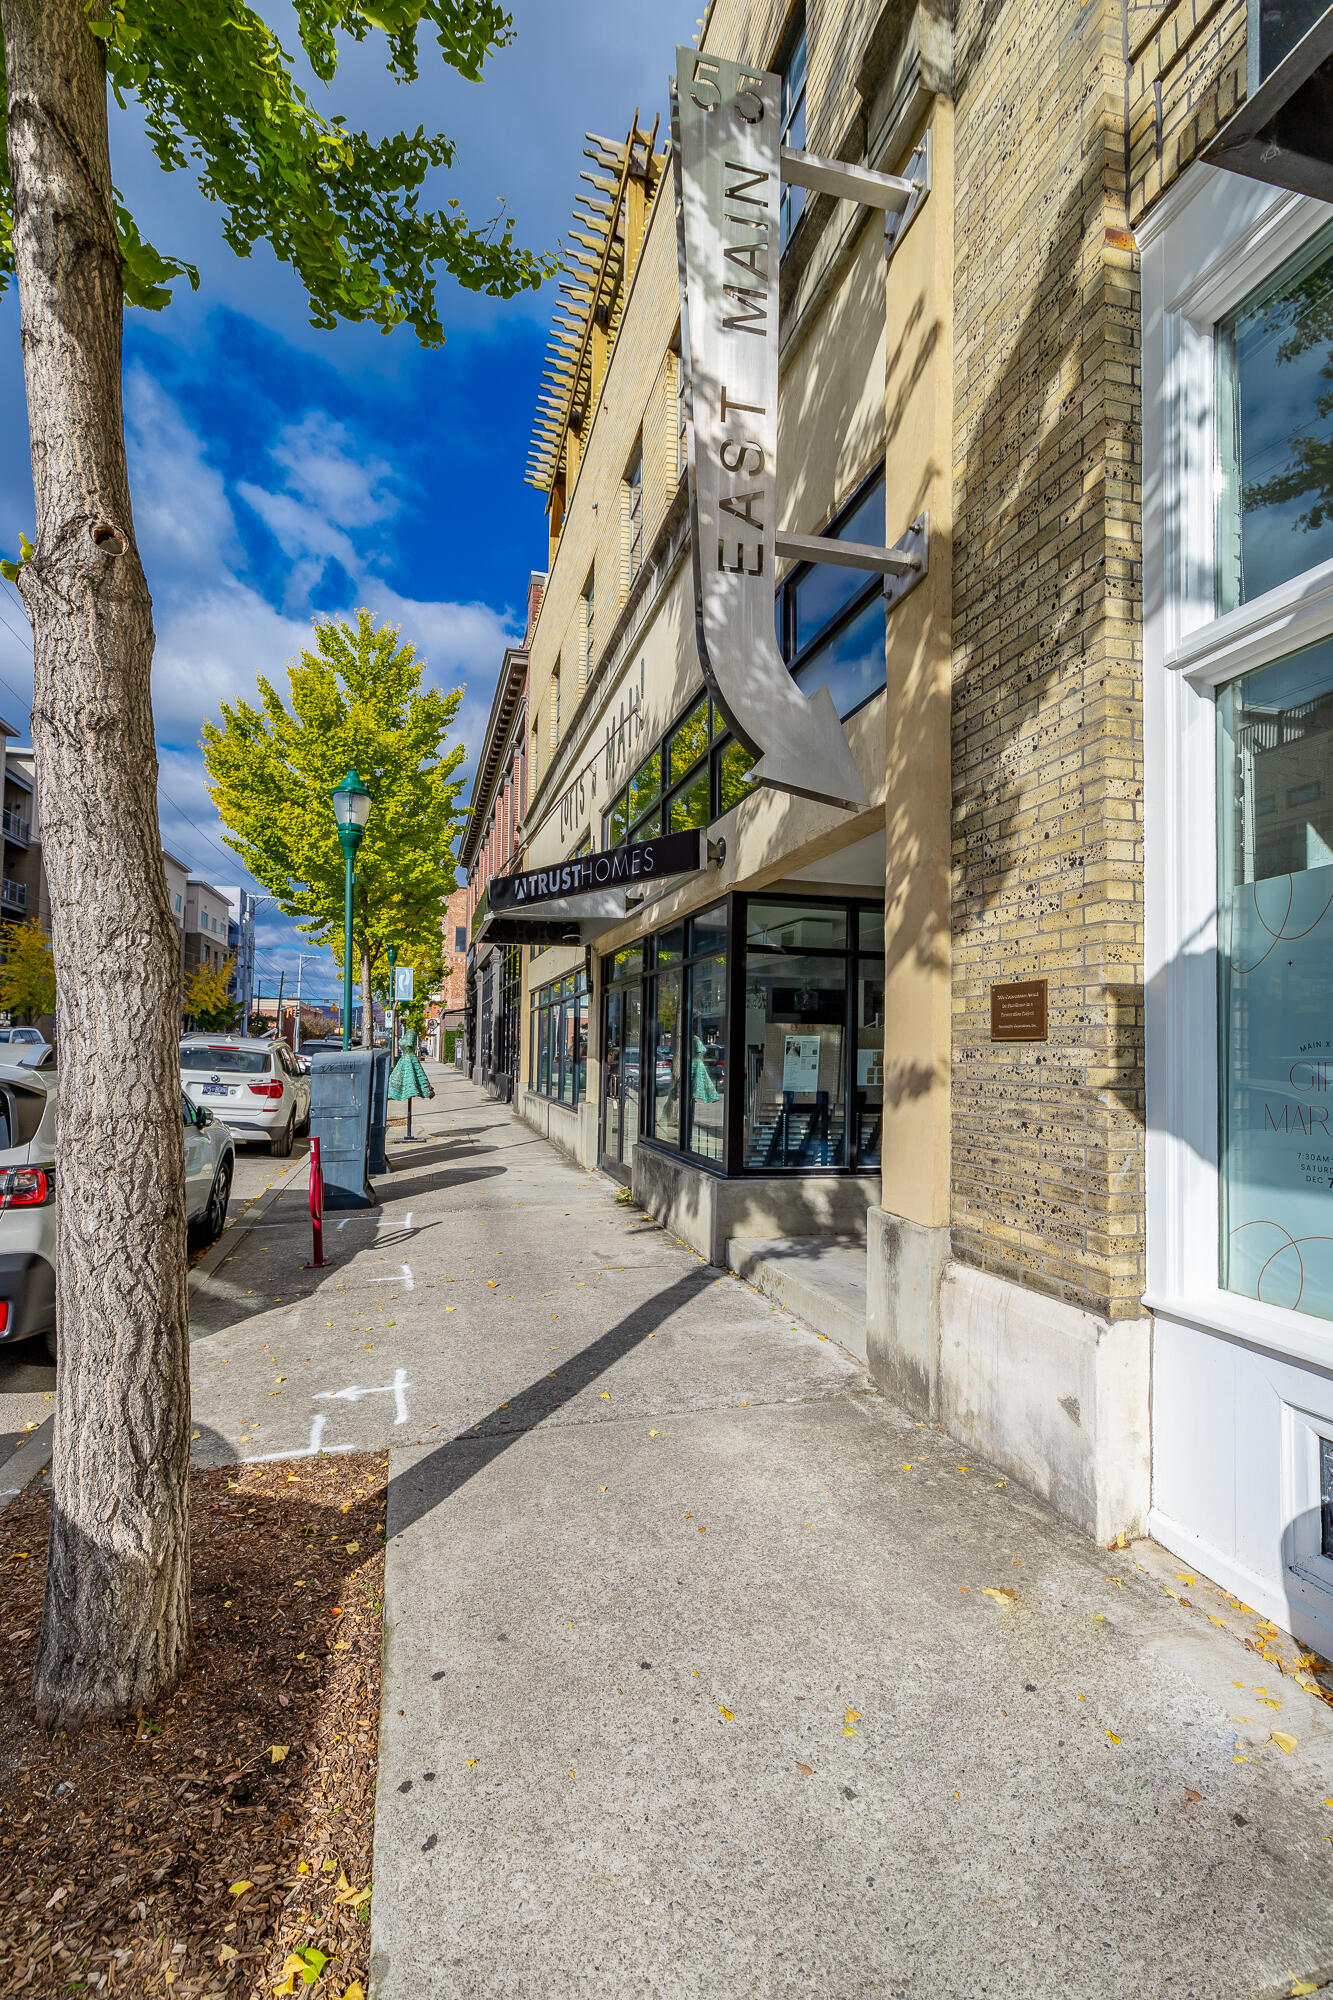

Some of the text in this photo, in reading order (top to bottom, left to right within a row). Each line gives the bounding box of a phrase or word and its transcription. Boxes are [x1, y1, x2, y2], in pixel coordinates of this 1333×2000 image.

[690, 59, 764, 124] 55
[718, 161, 769, 577] EAST MAIN
[1299, 1040, 1322, 1052] MAIN
[1305, 1175, 1324, 1184] DEC
